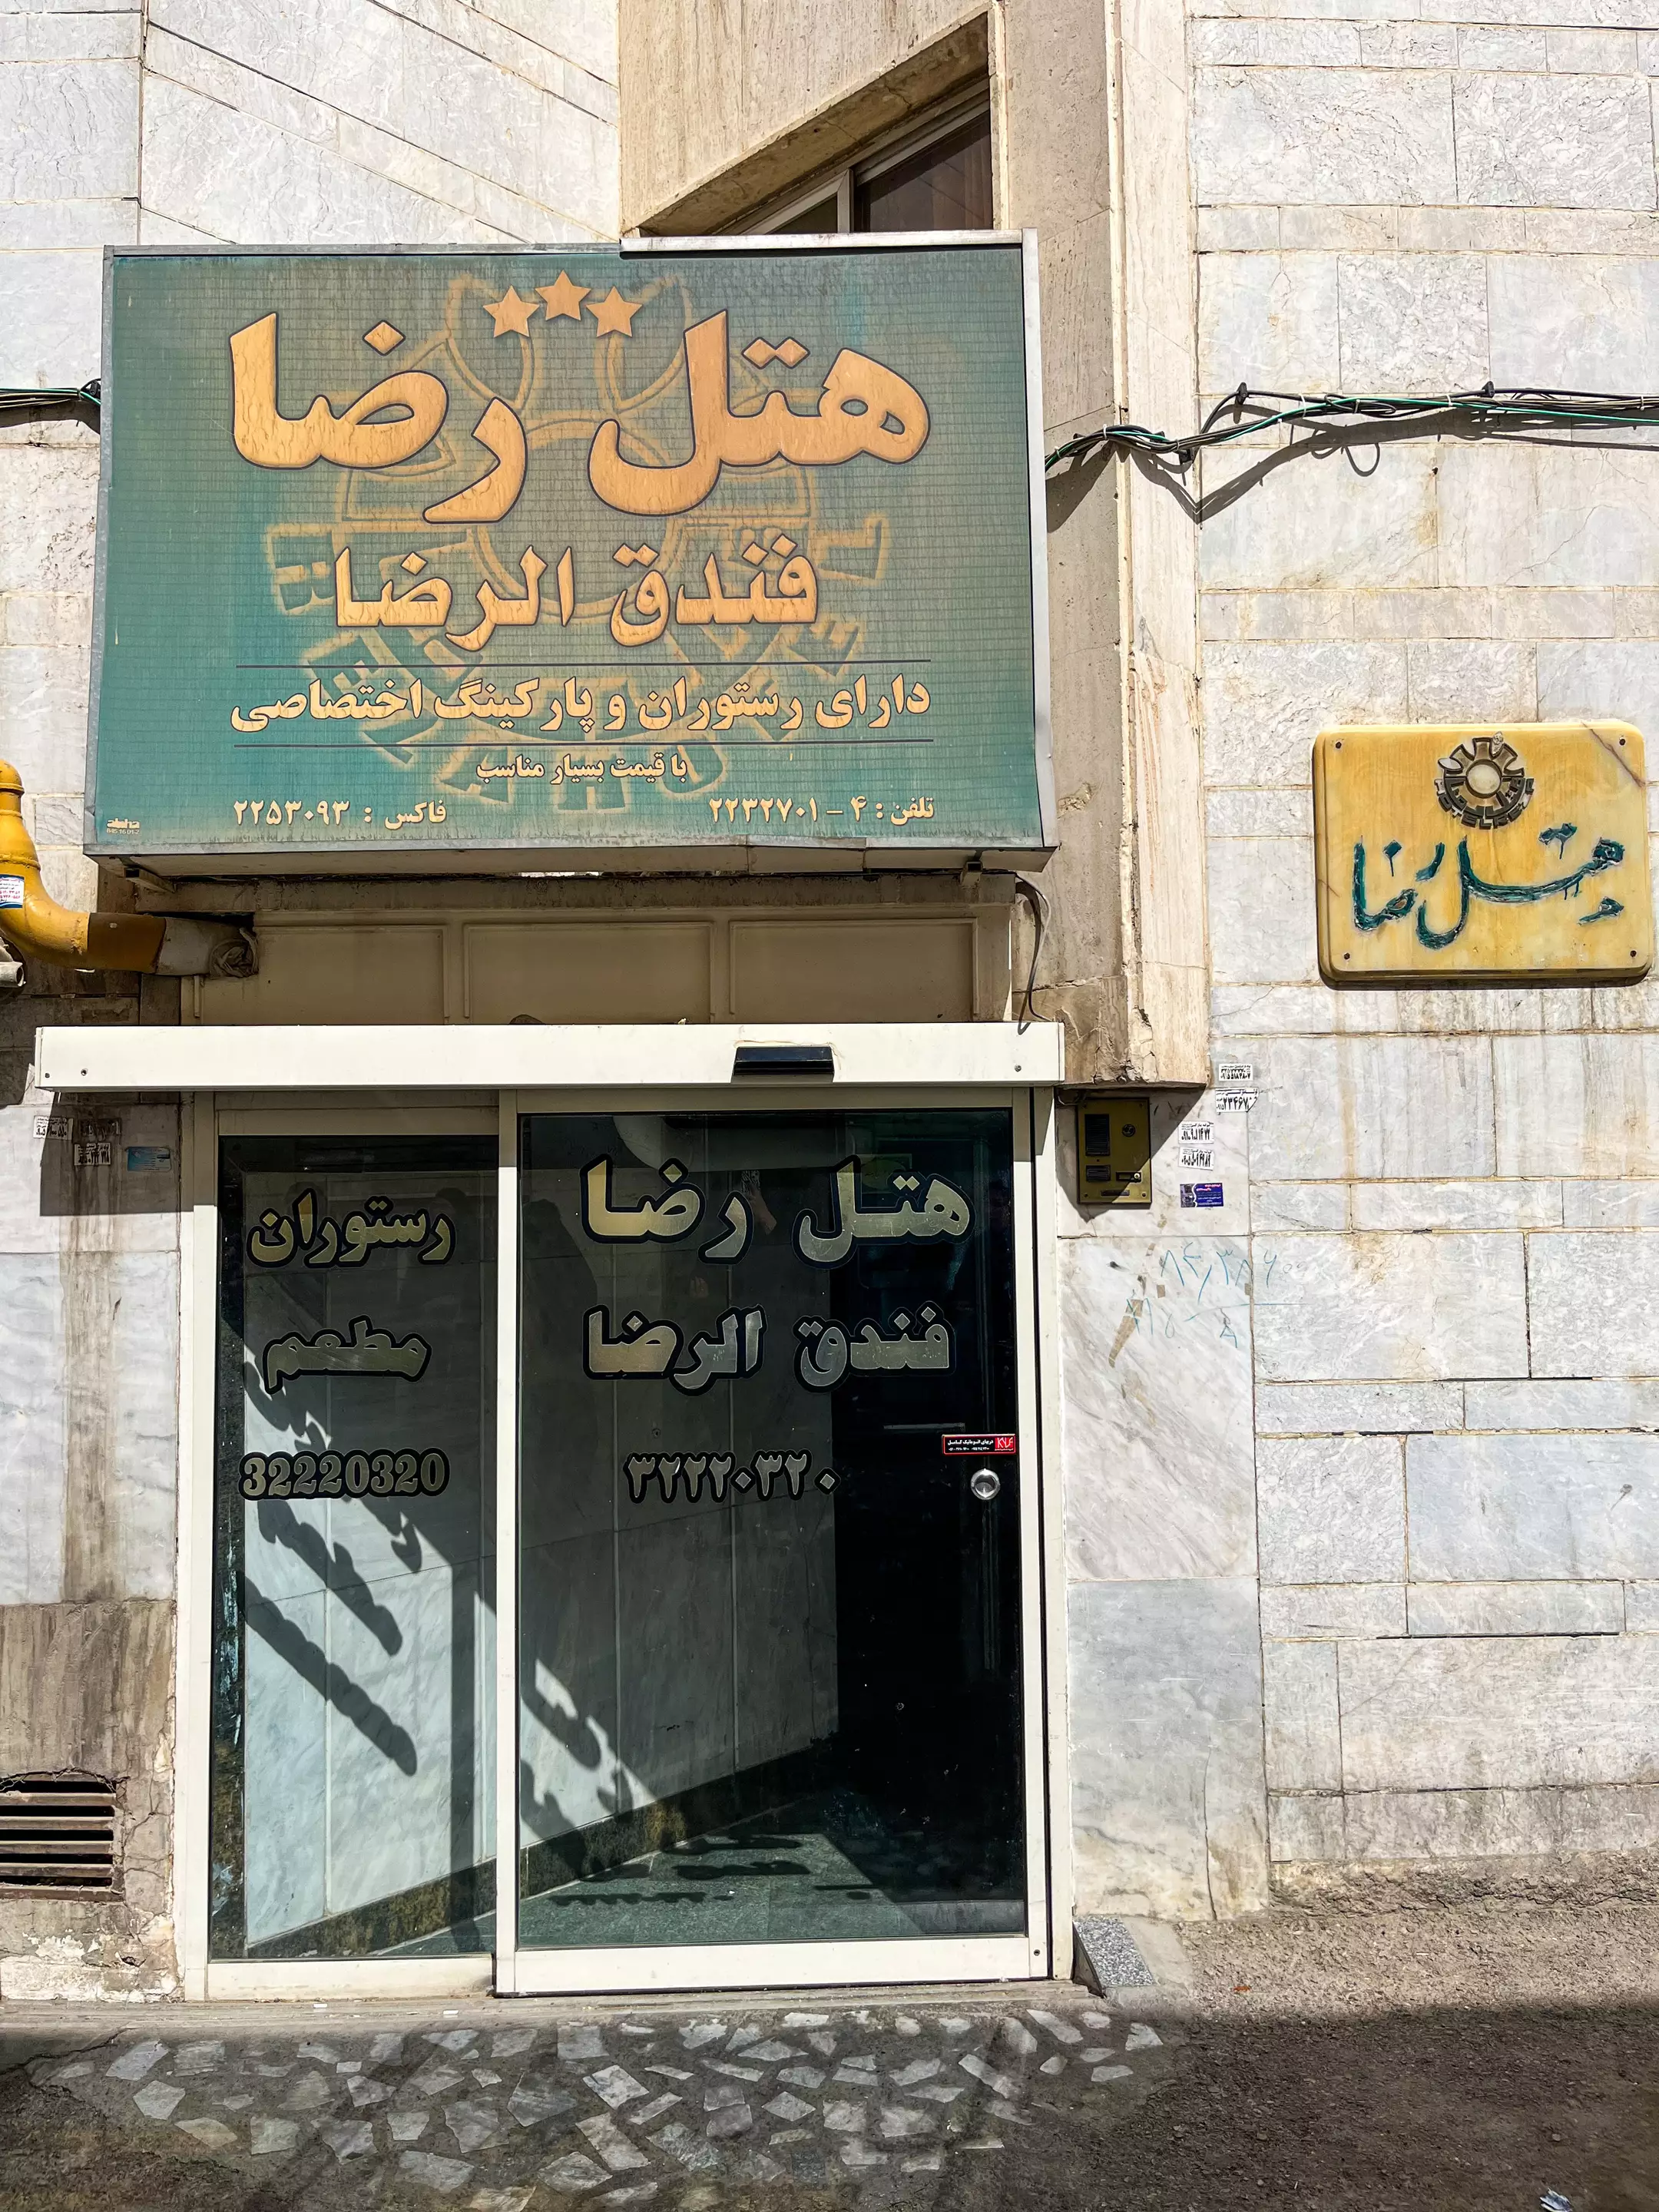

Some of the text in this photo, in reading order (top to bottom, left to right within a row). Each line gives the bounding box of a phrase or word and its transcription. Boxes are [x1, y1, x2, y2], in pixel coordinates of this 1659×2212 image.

[230, 309, 931, 524] هتل رضا
[333, 534, 817, 651] فندق الرضا
[230, 679, 423, 732] اختصاصی
[638, 677, 804, 730] رستوران
[815, 674, 931, 729] دارای
[475, 753, 688, 785] با قیمت بسیار مناسب
[233, 800, 350, 826] ۲۲۵۳۰۹۳
[250, 1190, 453, 1266] رستوران
[584, 1157, 972, 1264] هتل رضا
[265, 1316, 430, 1392] مطعم
[586, 1305, 952, 1391] فندق الرضا
[241, 1452, 447, 1498] 32220320
